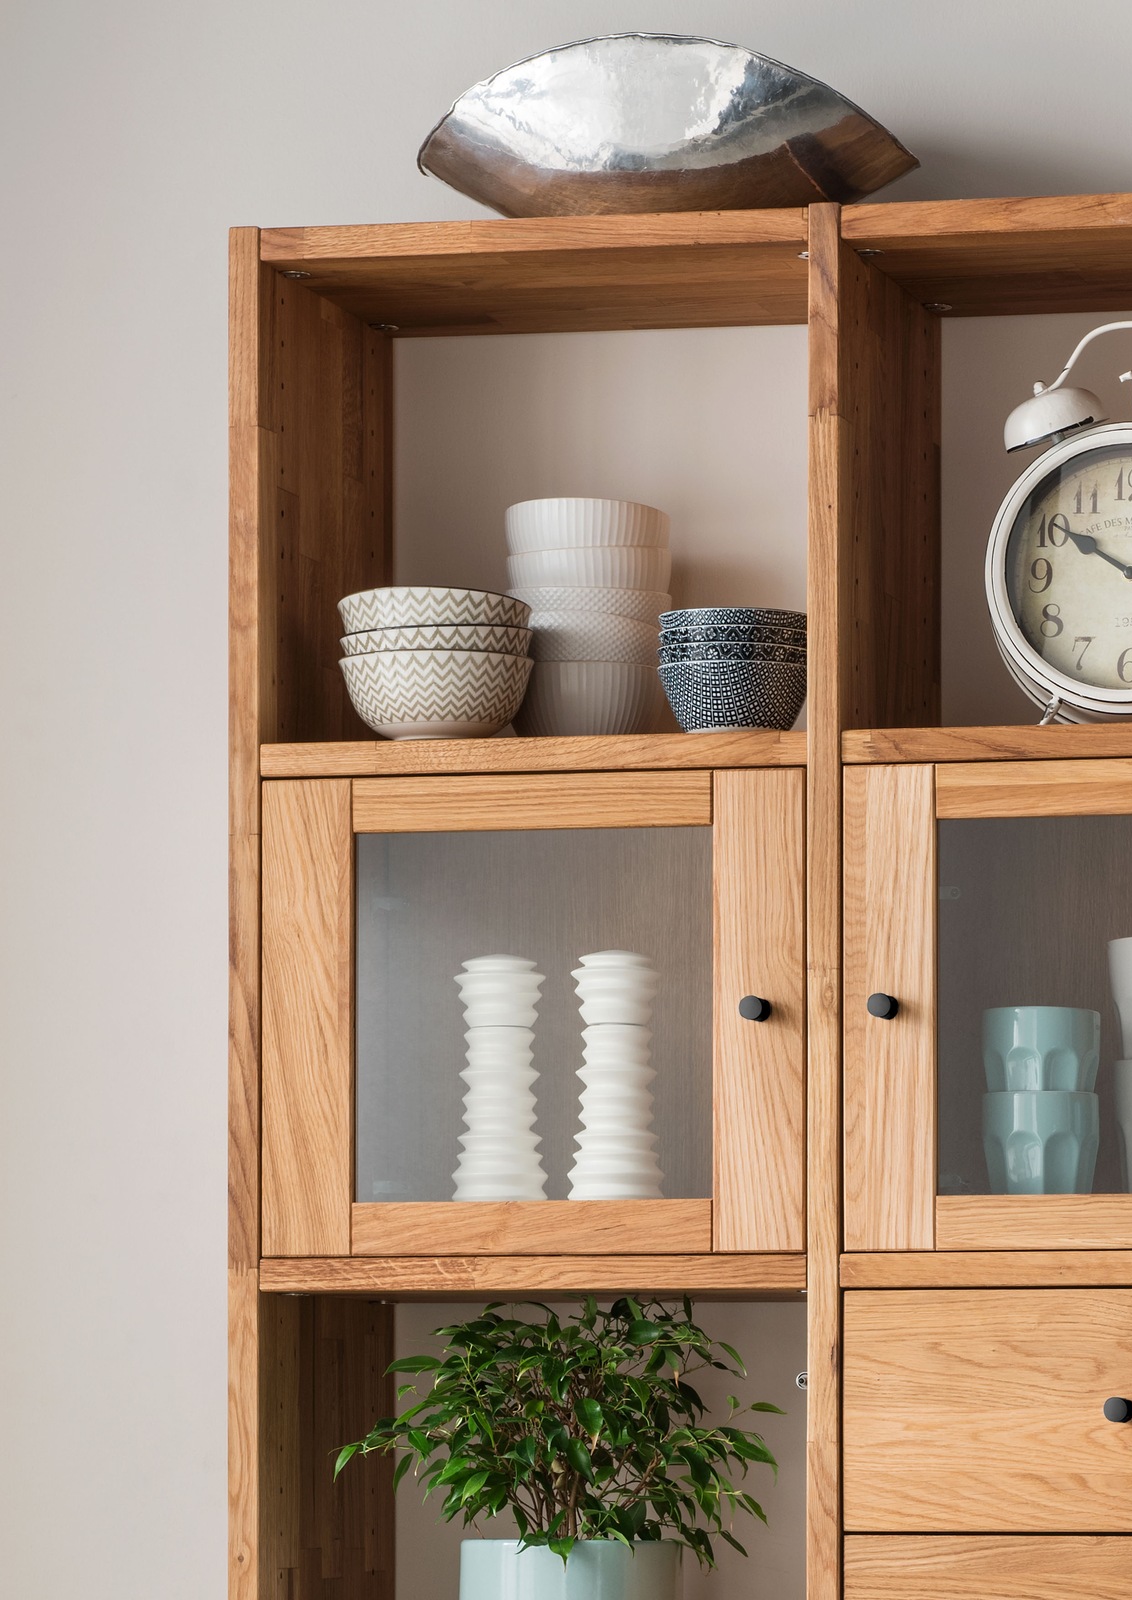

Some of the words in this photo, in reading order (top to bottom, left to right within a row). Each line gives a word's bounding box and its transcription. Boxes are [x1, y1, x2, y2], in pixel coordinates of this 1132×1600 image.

[1073, 480, 1100, 514] 11
[1036, 513, 1070, 548] 10
[1081, 523, 1102, 535] AFE
[1103, 517, 1123, 529] DES
[1028, 558, 1053, 593] 9
[1040, 603, 1064, 638] 8
[1072, 636, 1096, 671] 7
